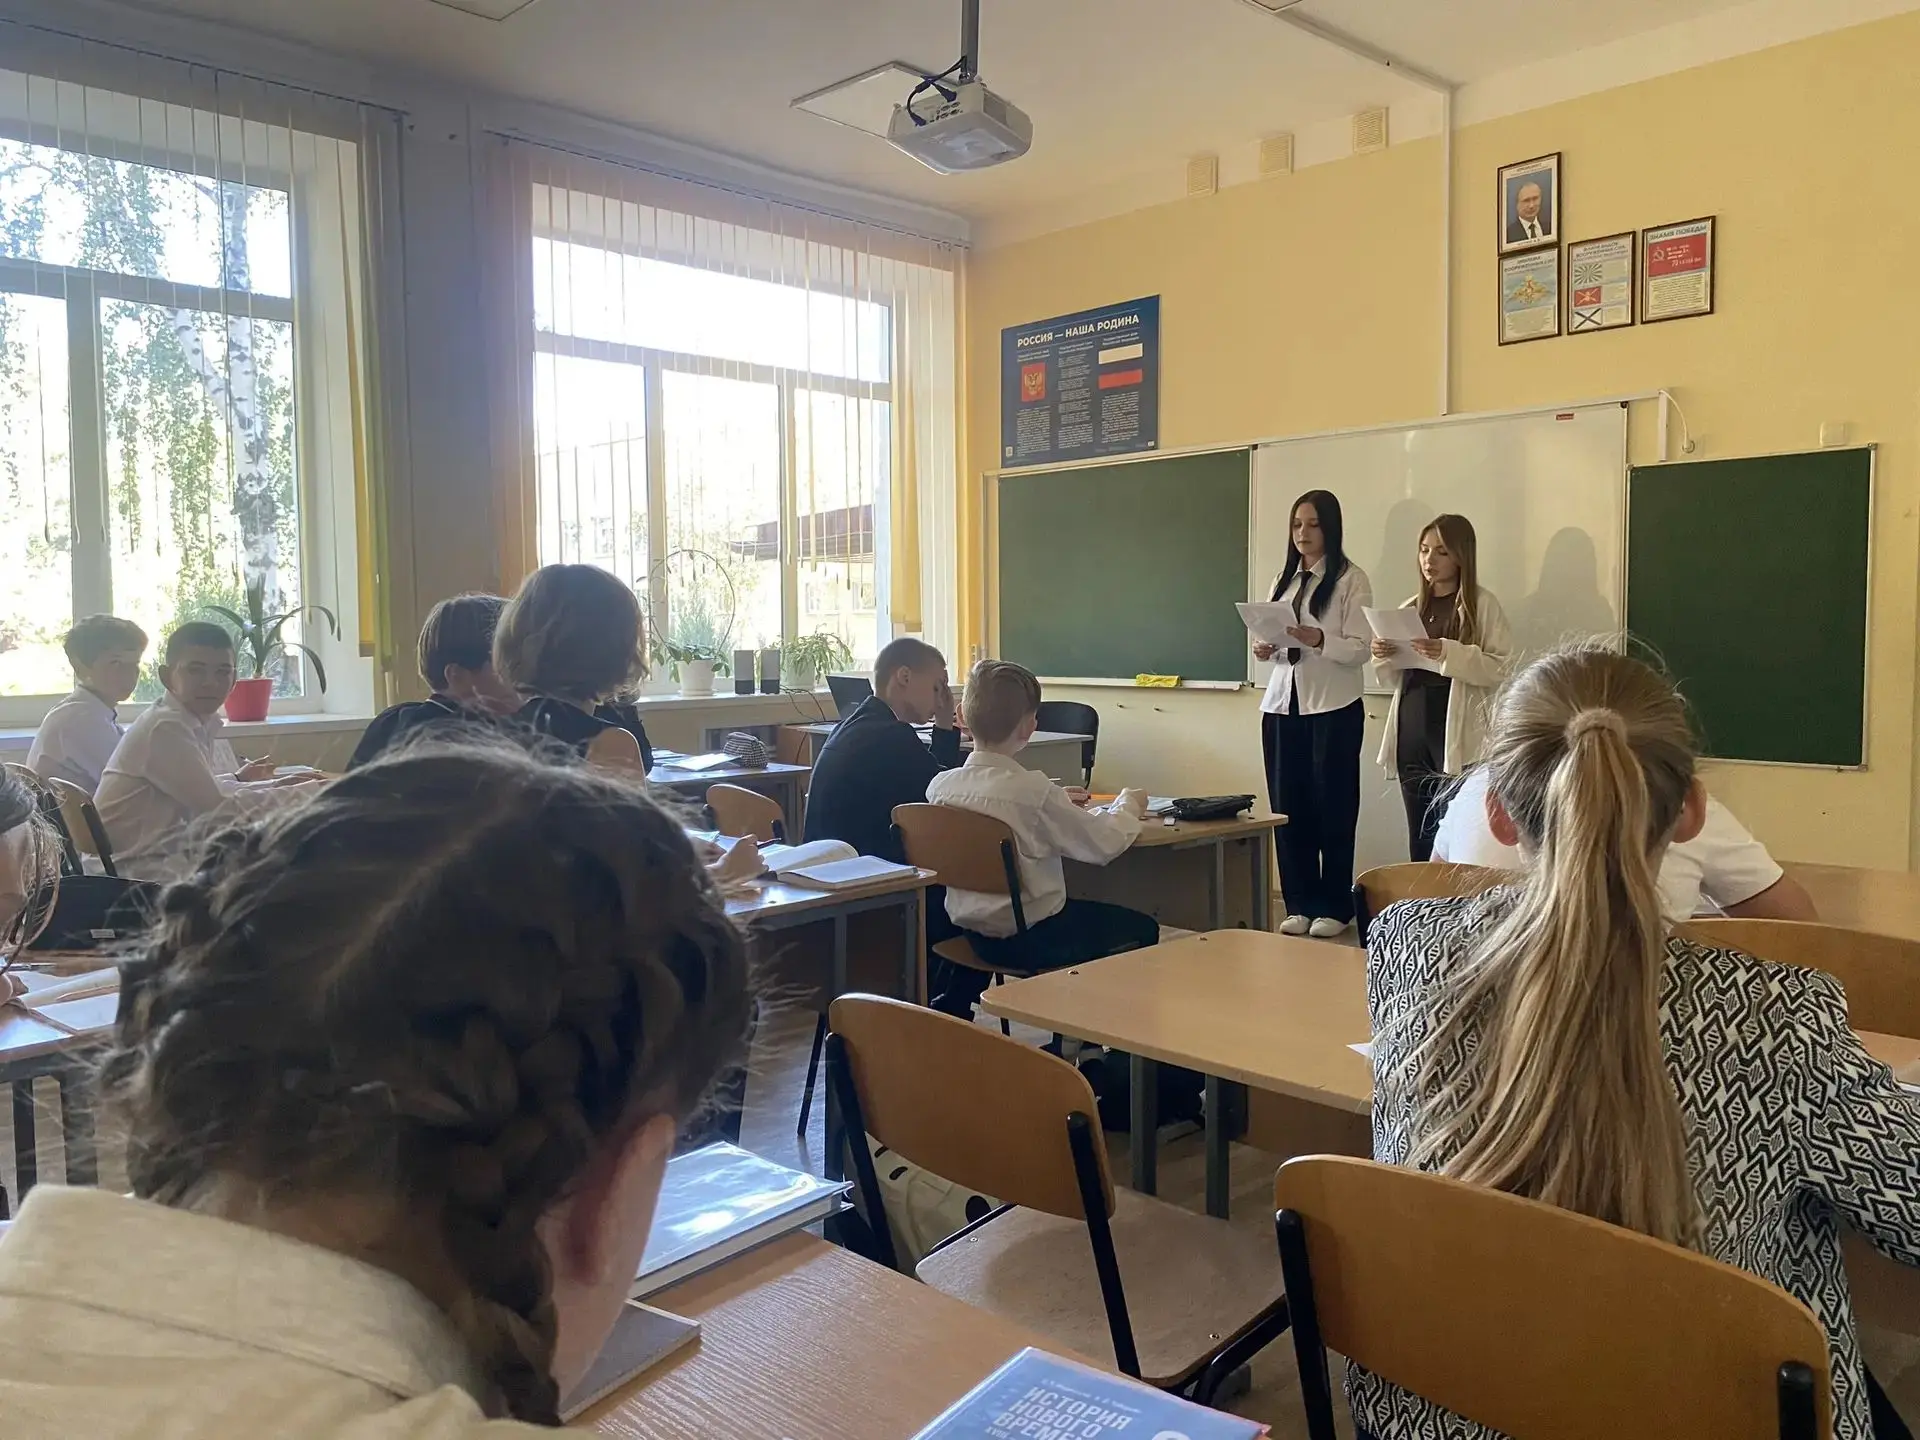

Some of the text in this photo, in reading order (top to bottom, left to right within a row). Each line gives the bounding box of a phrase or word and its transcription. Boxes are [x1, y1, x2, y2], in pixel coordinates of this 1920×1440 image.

[1017, 332, 1053, 348] РОССИЯ
[1065, 324, 1095, 338] НАША
[1097, 314, 1140, 331] РОДИНА
[993, 1412, 1082, 1440] ВРЕМЕ
[1008, 1399, 1104, 1438] НОВОГО
[1022, 1386, 1133, 1430] ИСТОРИЯ
